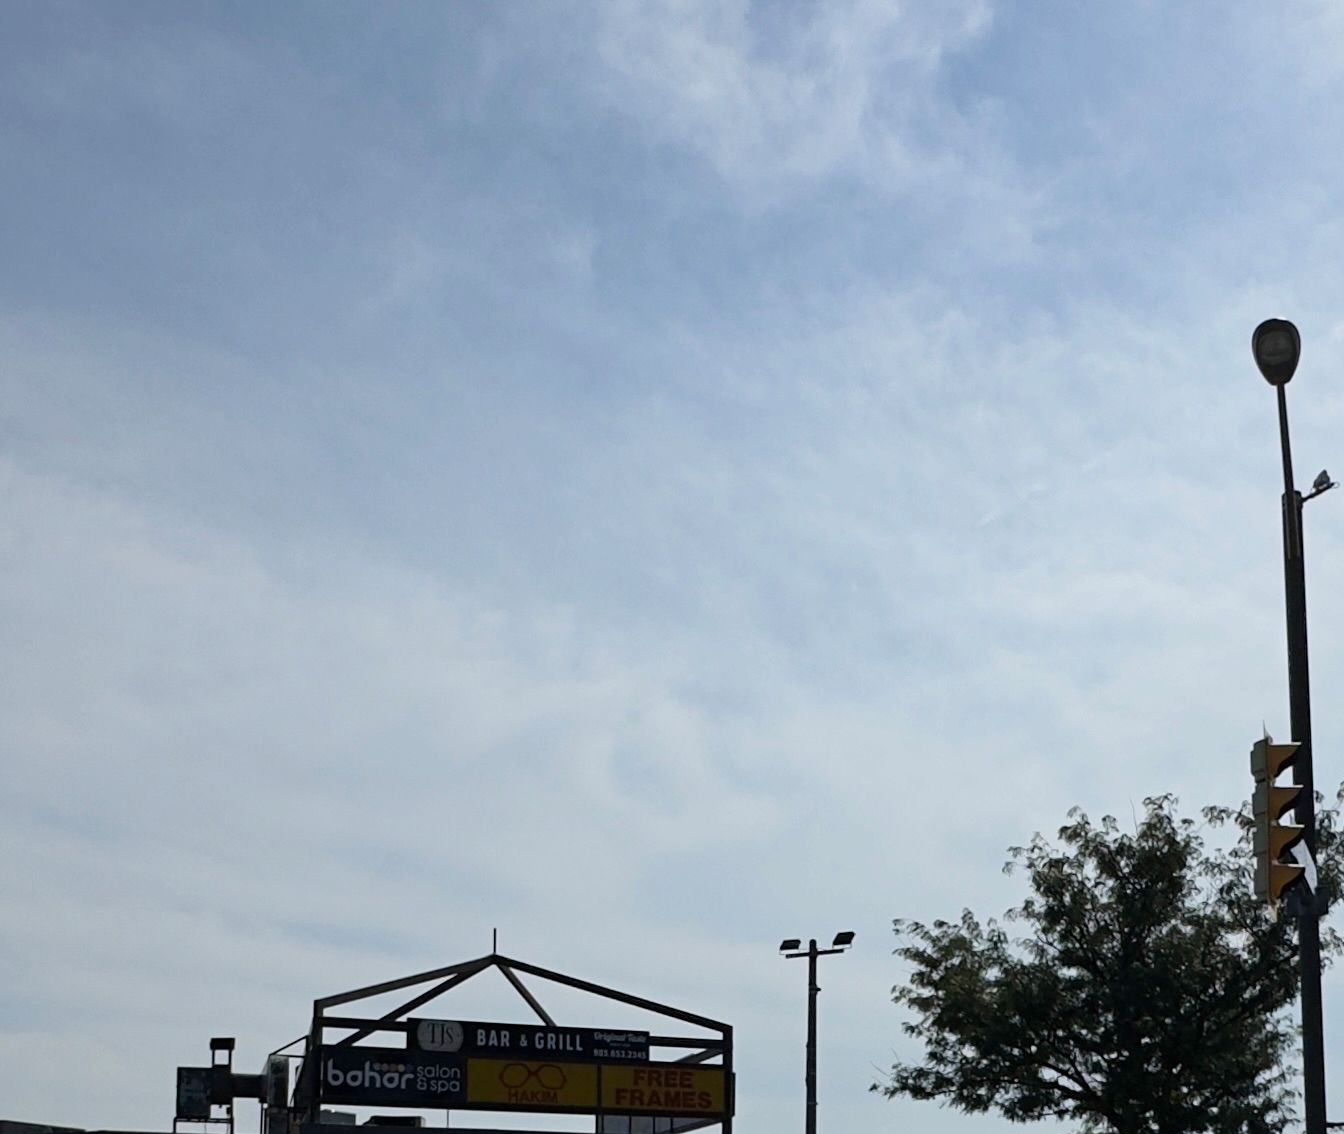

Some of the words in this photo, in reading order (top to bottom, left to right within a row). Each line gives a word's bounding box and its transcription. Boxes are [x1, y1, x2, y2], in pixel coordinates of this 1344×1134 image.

[476, 1028, 510, 1047] BAR
[520, 1033, 528, 1047] &
[534, 1032, 583, 1051] GRILL
[327, 1058, 415, 1089] bahar
[416, 1064, 461, 1079] salon
[634, 1069, 694, 1088] FREE
[416, 1077, 427, 1091] &
[430, 1080, 460, 1093] spa
[507, 1088, 559, 1104] HAKIM
[616, 1088, 712, 1108] FRAMES
